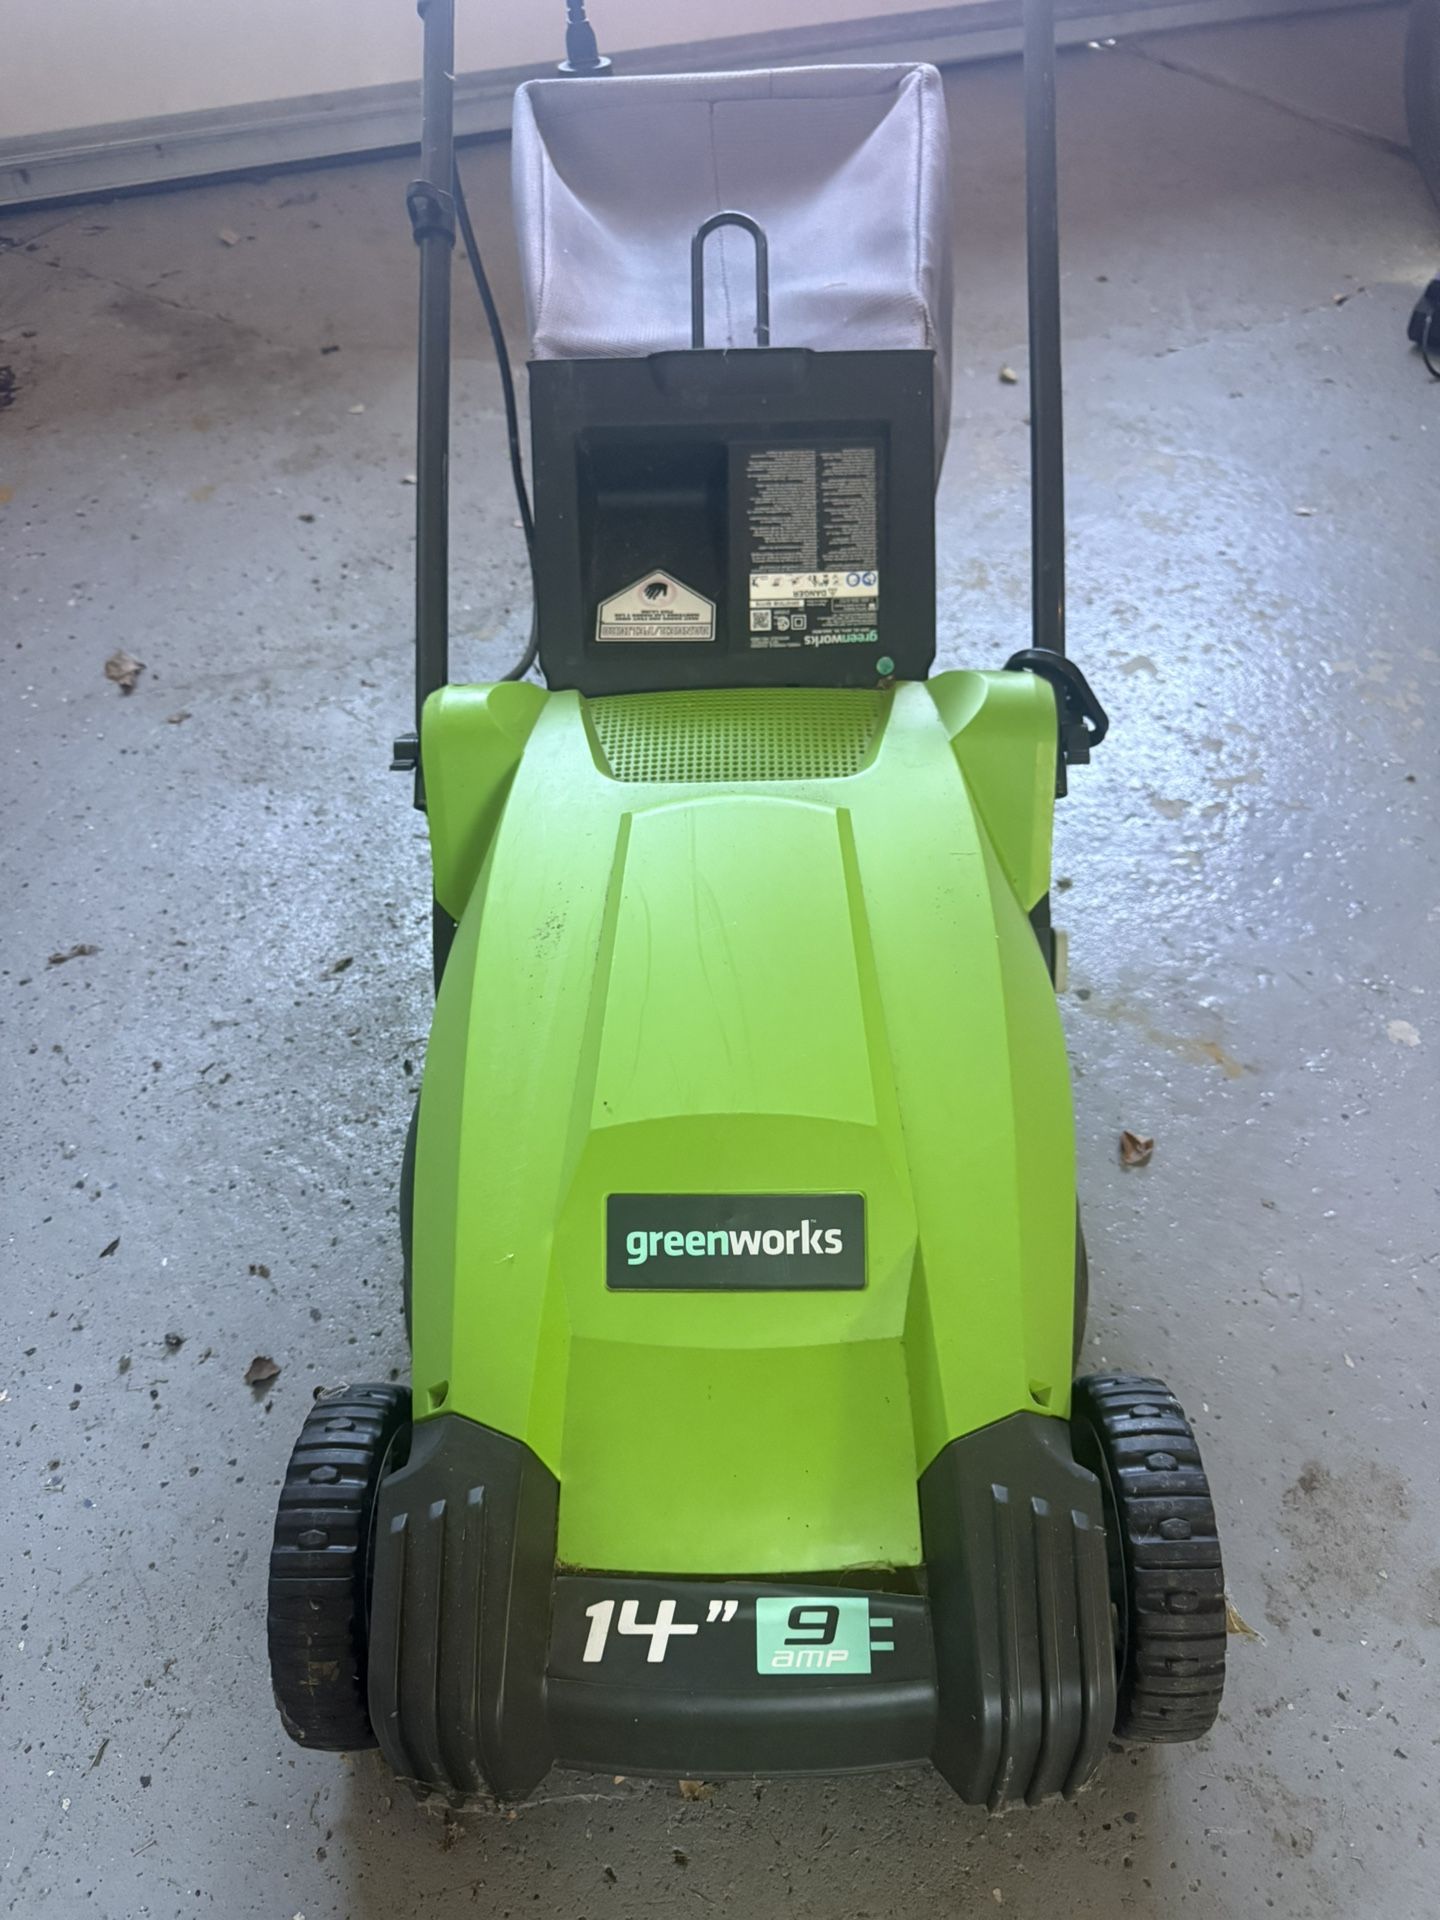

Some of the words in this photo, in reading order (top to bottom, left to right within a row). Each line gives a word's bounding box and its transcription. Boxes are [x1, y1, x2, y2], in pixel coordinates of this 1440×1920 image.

[793, 589, 827, 598] DANGER
[804, 629, 878, 647] greenworks
[626, 1219, 843, 1265] greenworks
[784, 1605, 840, 1645] 9
